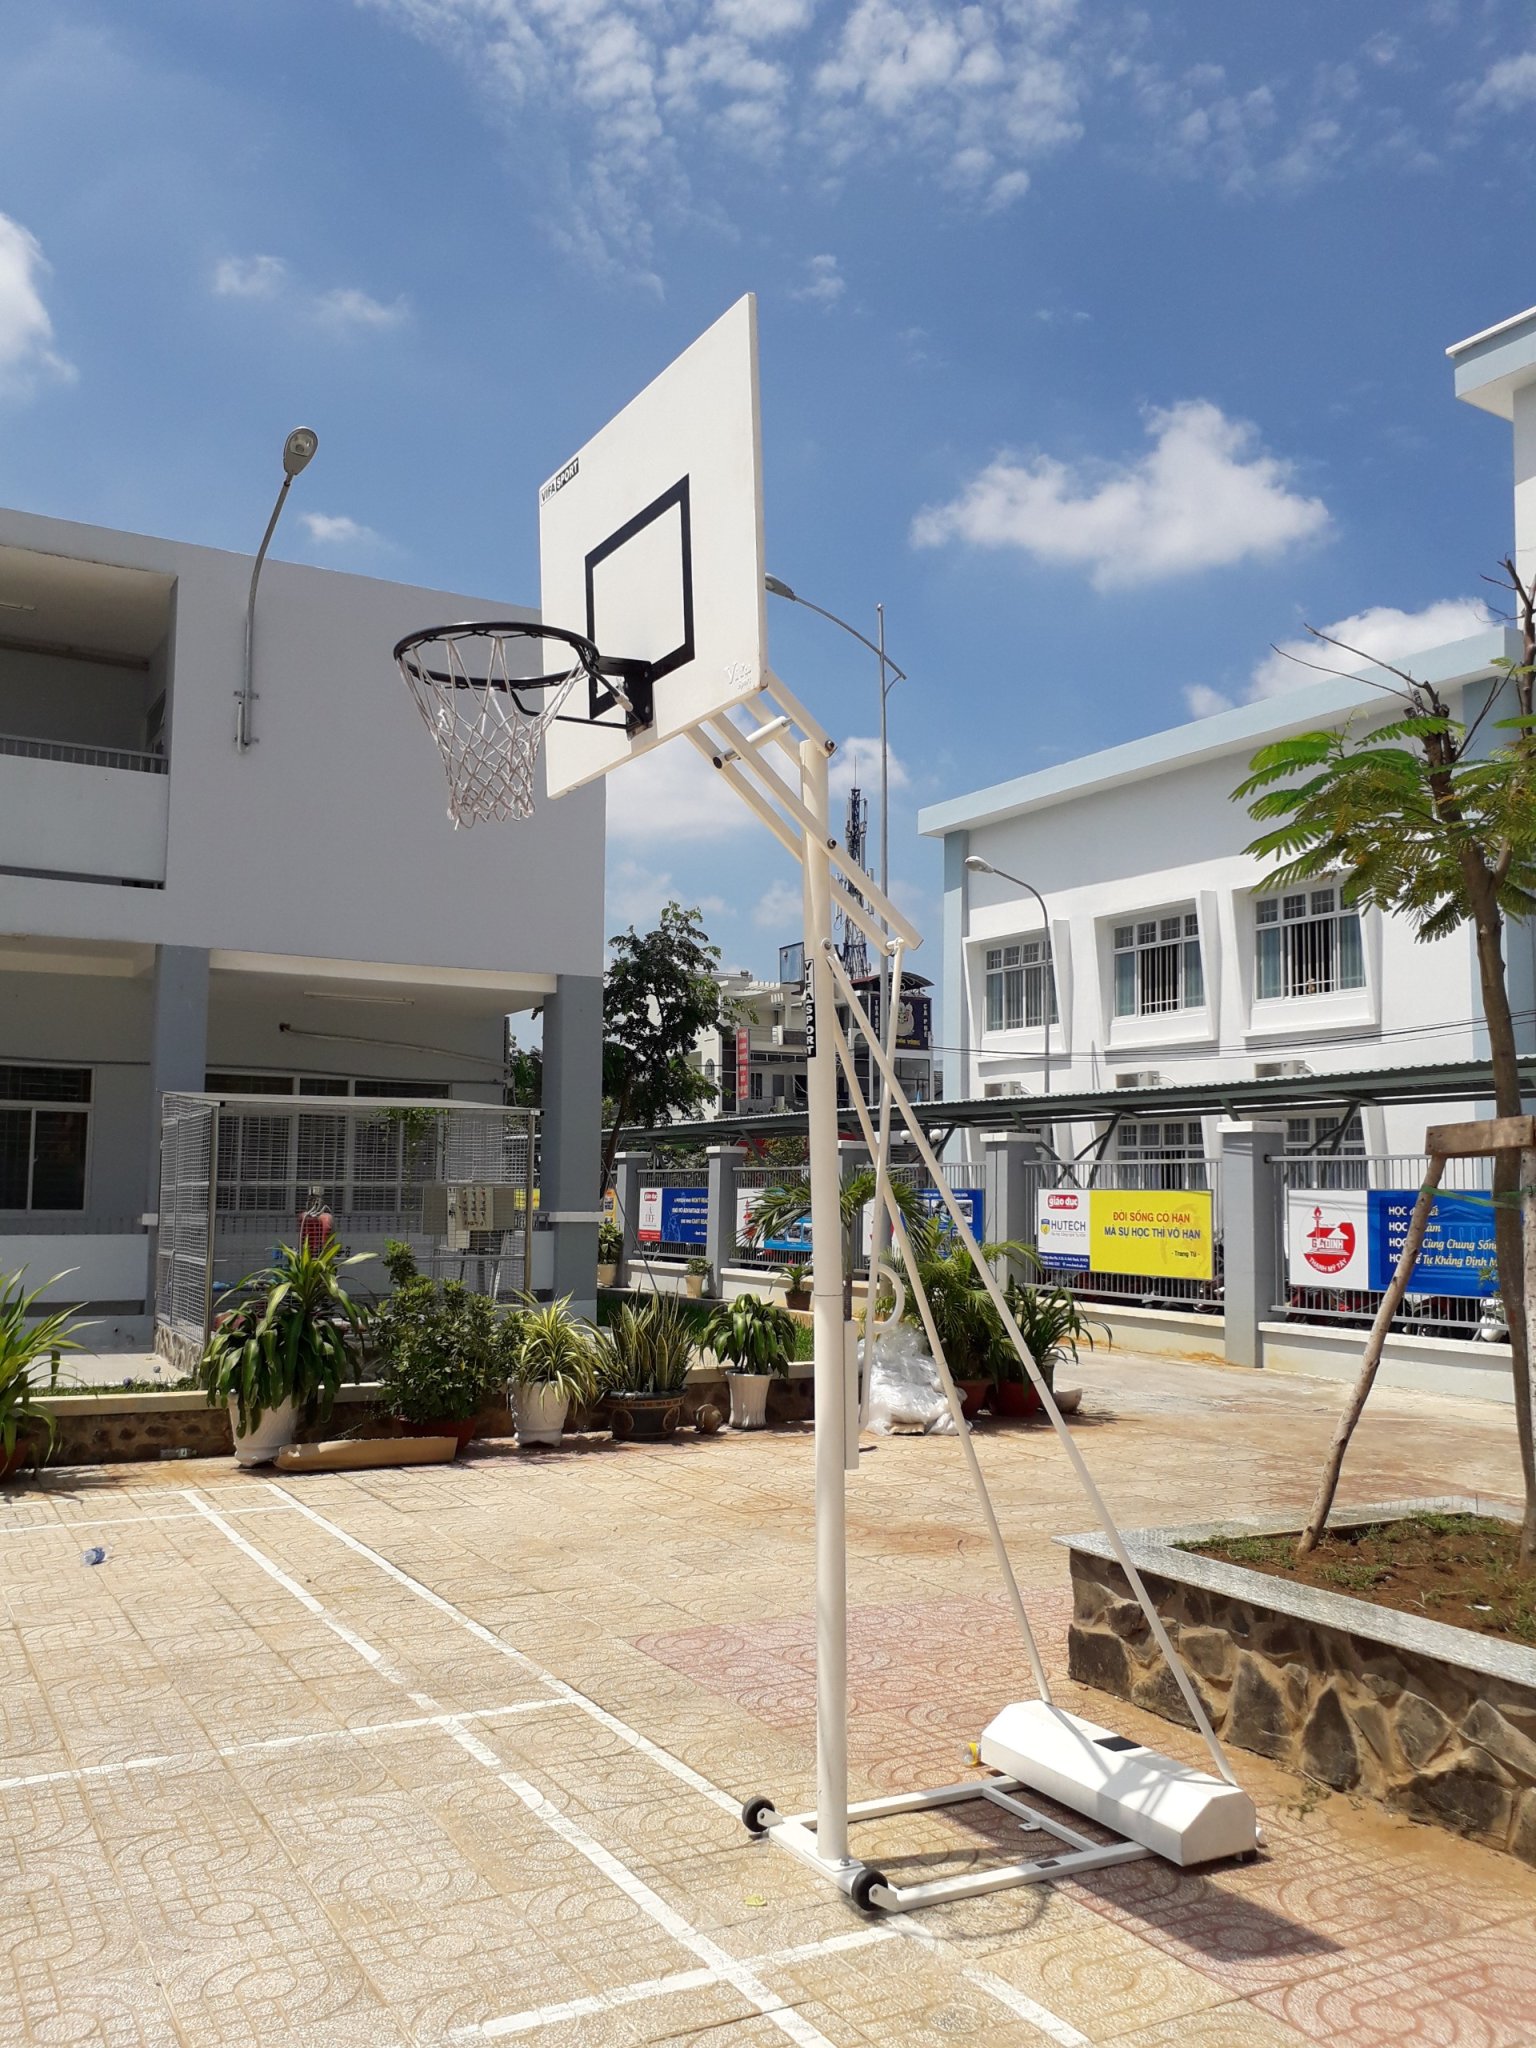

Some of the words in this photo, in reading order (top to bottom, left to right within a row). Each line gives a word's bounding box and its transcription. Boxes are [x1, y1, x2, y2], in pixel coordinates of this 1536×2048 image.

[541, 459, 579, 502] VIFASPORT
[804, 961, 815, 1055] VIFASPORT
[1388, 1206, 1408, 1217] HỌC
[1051, 1219, 1086, 1231] HUTECH
[1388, 1222, 1408, 1233] HỌC
[1131, 1227, 1150, 1239] HỌC
[1422, 1238, 1445, 1250] Cùng
[1446, 1238, 1475, 1251] Chung
[1465, 1255, 1487, 1268] Định
